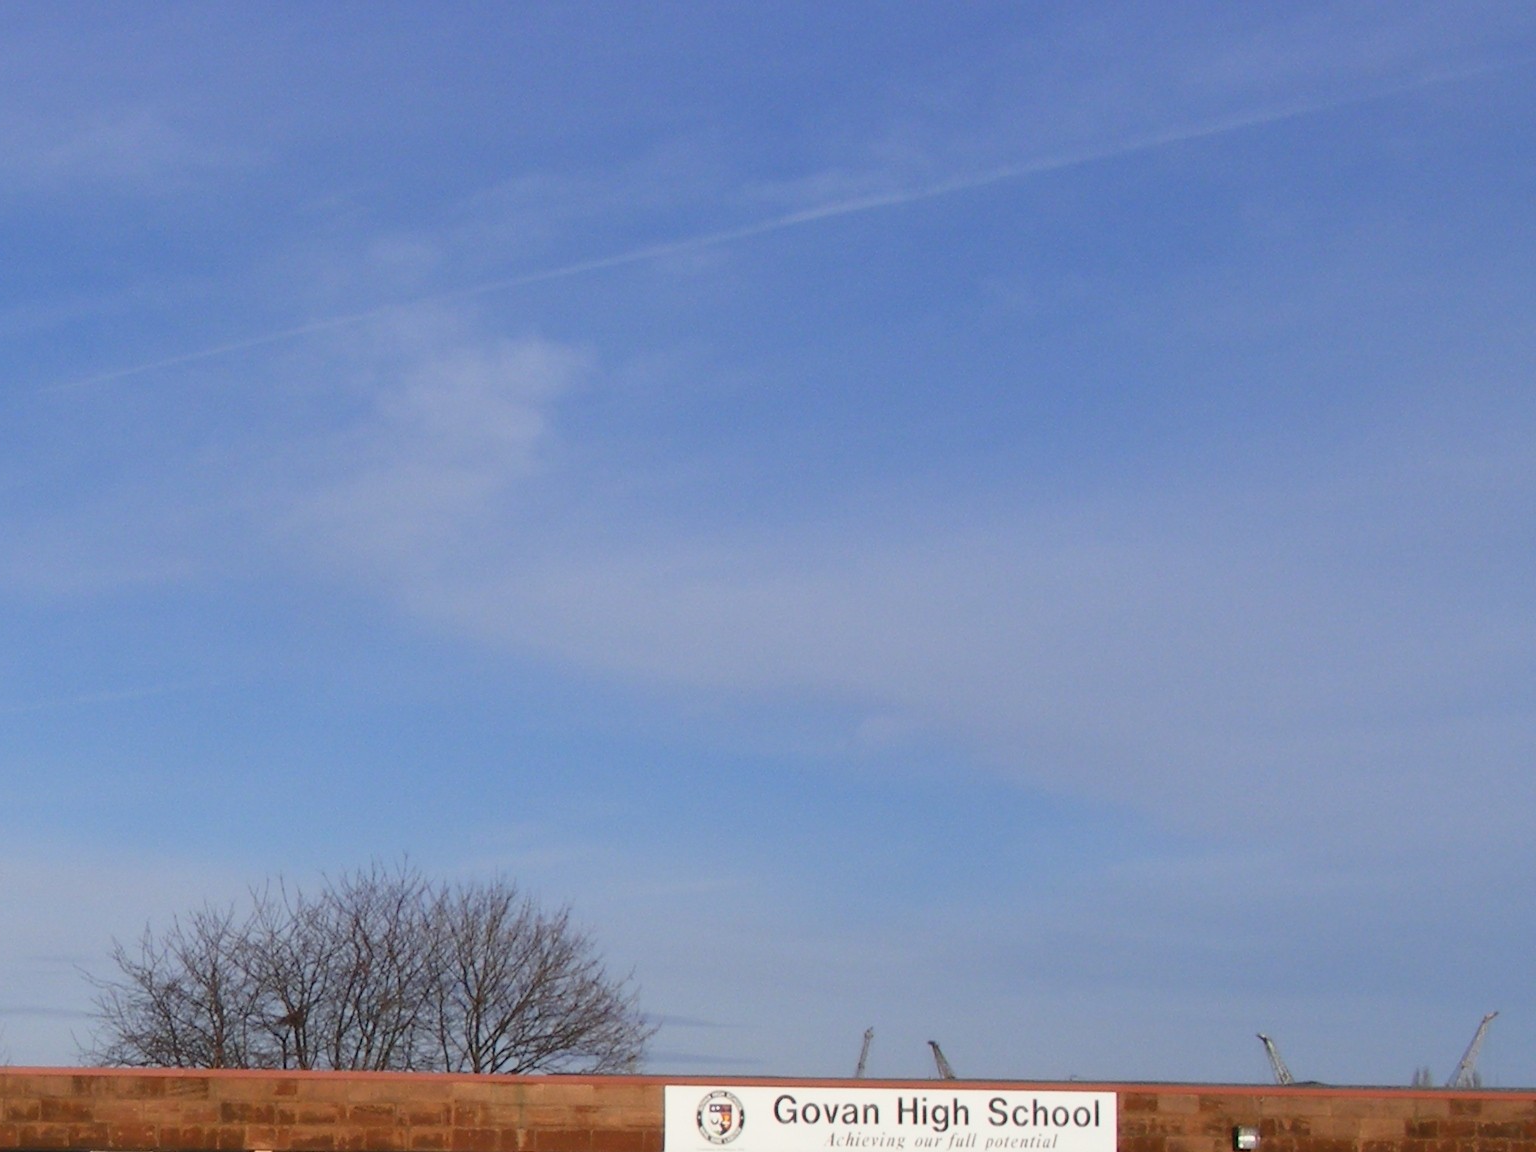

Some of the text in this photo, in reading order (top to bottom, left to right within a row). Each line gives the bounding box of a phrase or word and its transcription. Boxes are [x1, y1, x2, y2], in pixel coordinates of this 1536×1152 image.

[774, 1094, 879, 1124] Govan
[897, 1097, 969, 1132] High
[988, 1097, 1100, 1127] School
[824, 1132, 1058, 1150] Achieving our full potential
